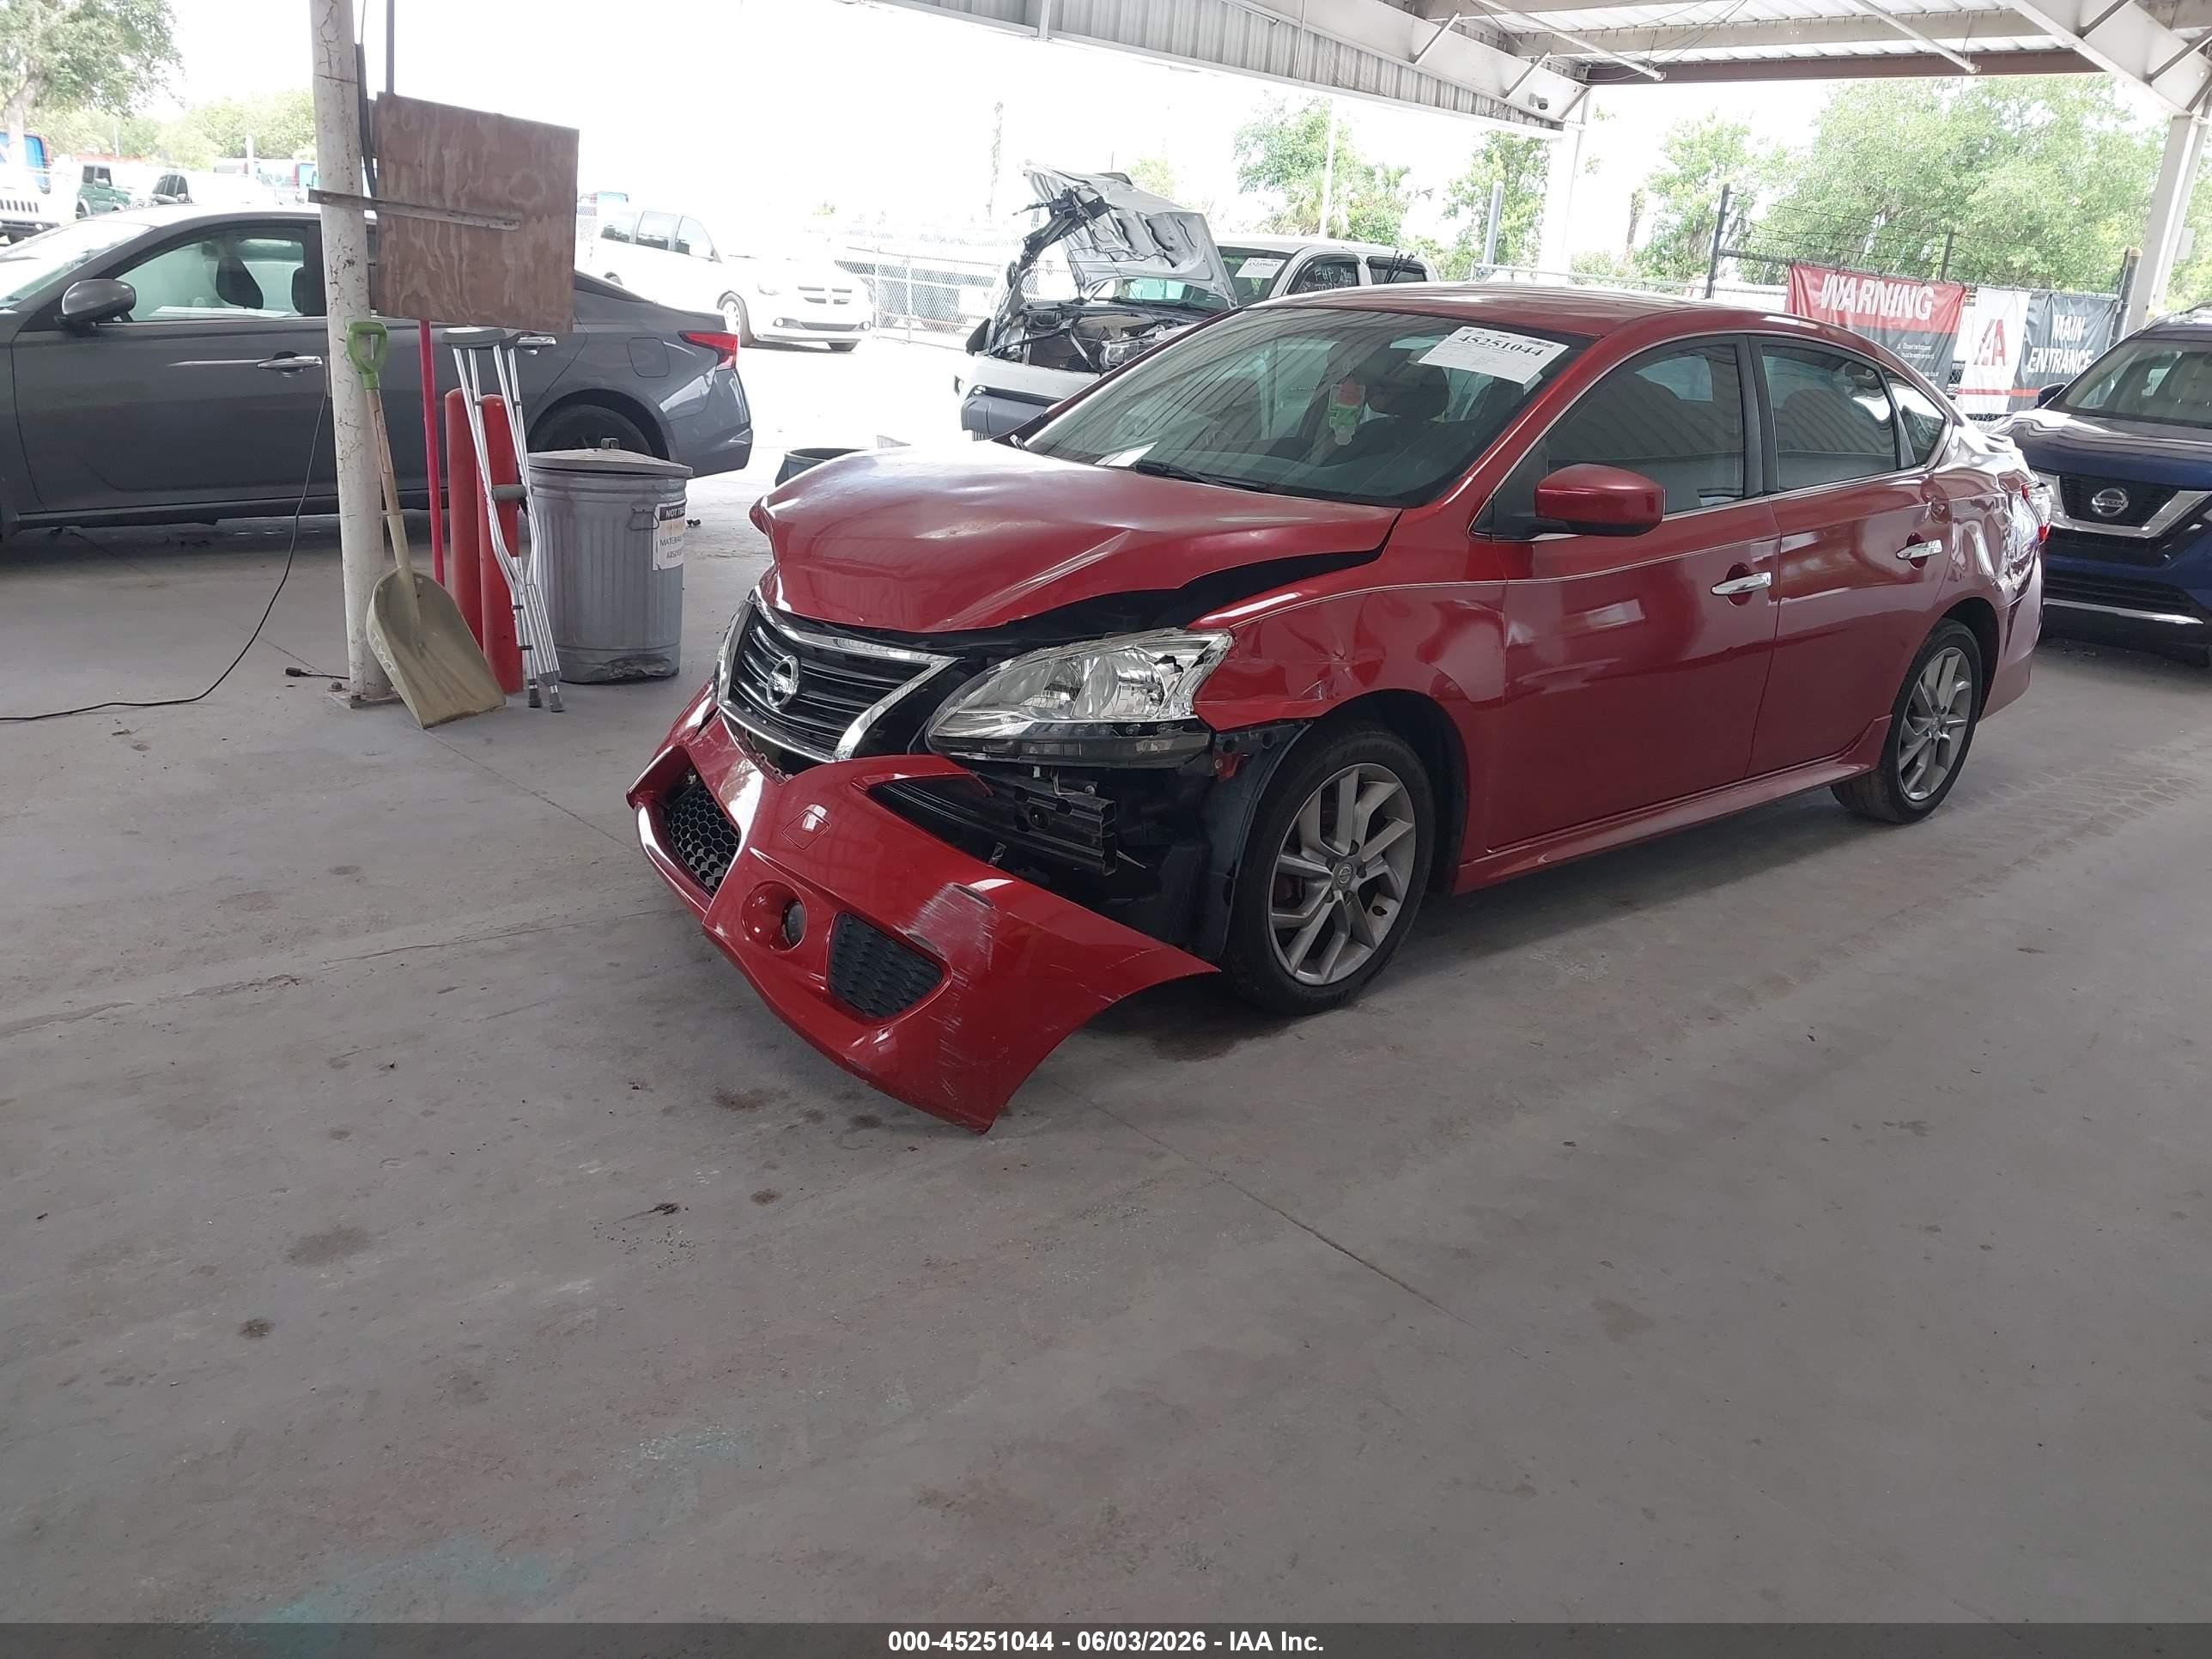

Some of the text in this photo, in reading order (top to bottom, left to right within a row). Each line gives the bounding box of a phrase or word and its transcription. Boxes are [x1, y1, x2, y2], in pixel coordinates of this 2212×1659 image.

[1820, 273, 1934, 320] WARNING
[2051, 314, 2087, 342] MAIN
[1459, 335, 1544, 356] 45251044
[2027, 347, 2094, 374] ENTRANCE
